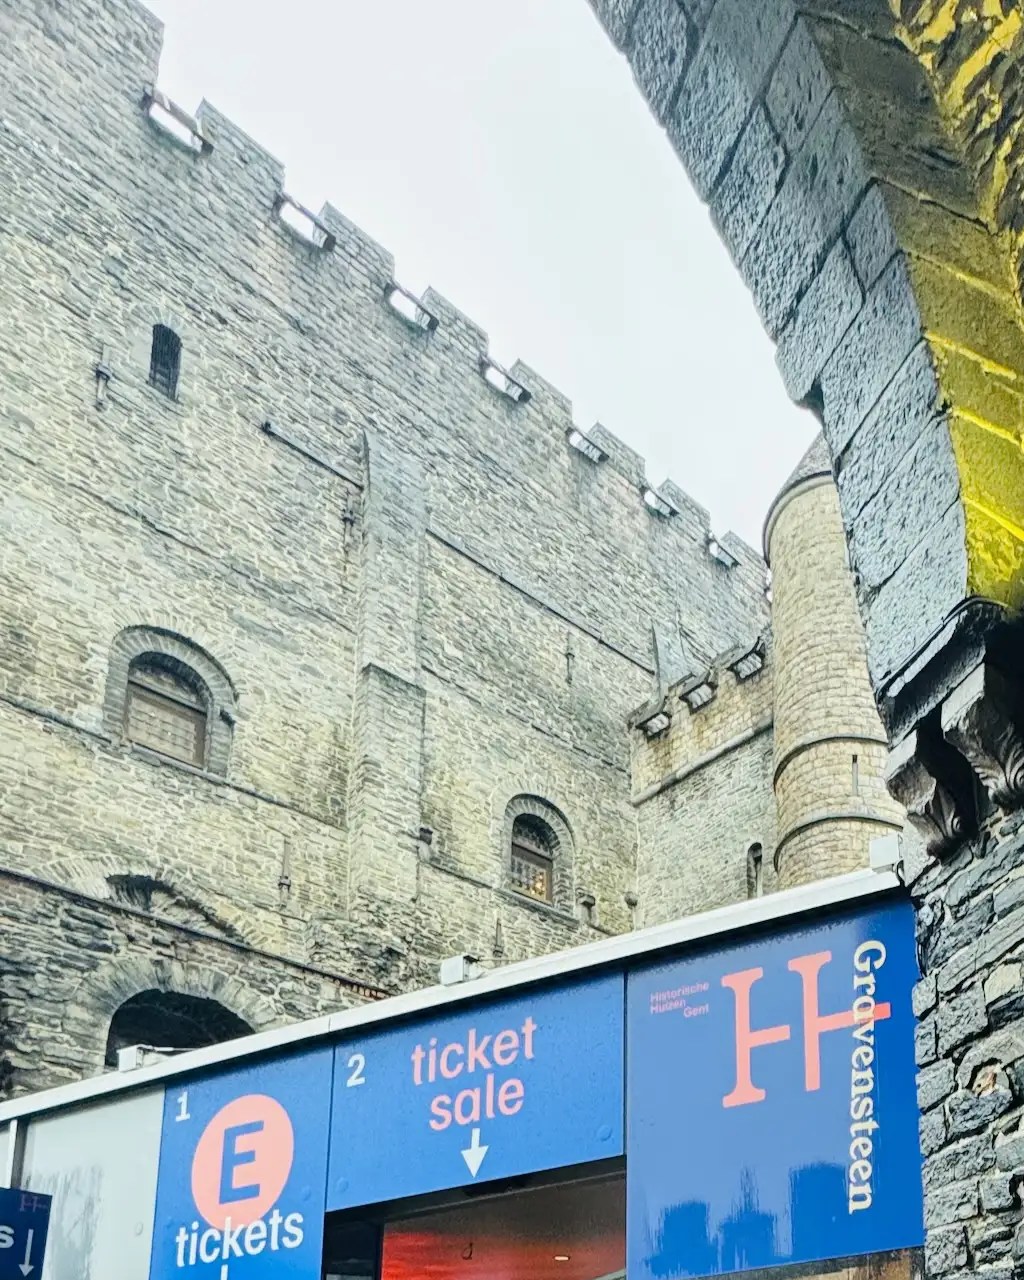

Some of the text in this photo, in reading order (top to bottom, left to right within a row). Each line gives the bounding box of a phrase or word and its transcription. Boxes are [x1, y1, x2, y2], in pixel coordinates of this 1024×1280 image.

[683, 1003, 709, 1018] Gent
[346, 1054, 366, 1088] 2
[410, 1016, 538, 1086] ticket
[848, 939, 887, 1215] Gravensteen
[175, 1091, 191, 1122] 1
[429, 1073, 524, 1131] sale
[218, 1120, 265, 1205] E
[175, 1209, 304, 1268] tickets
